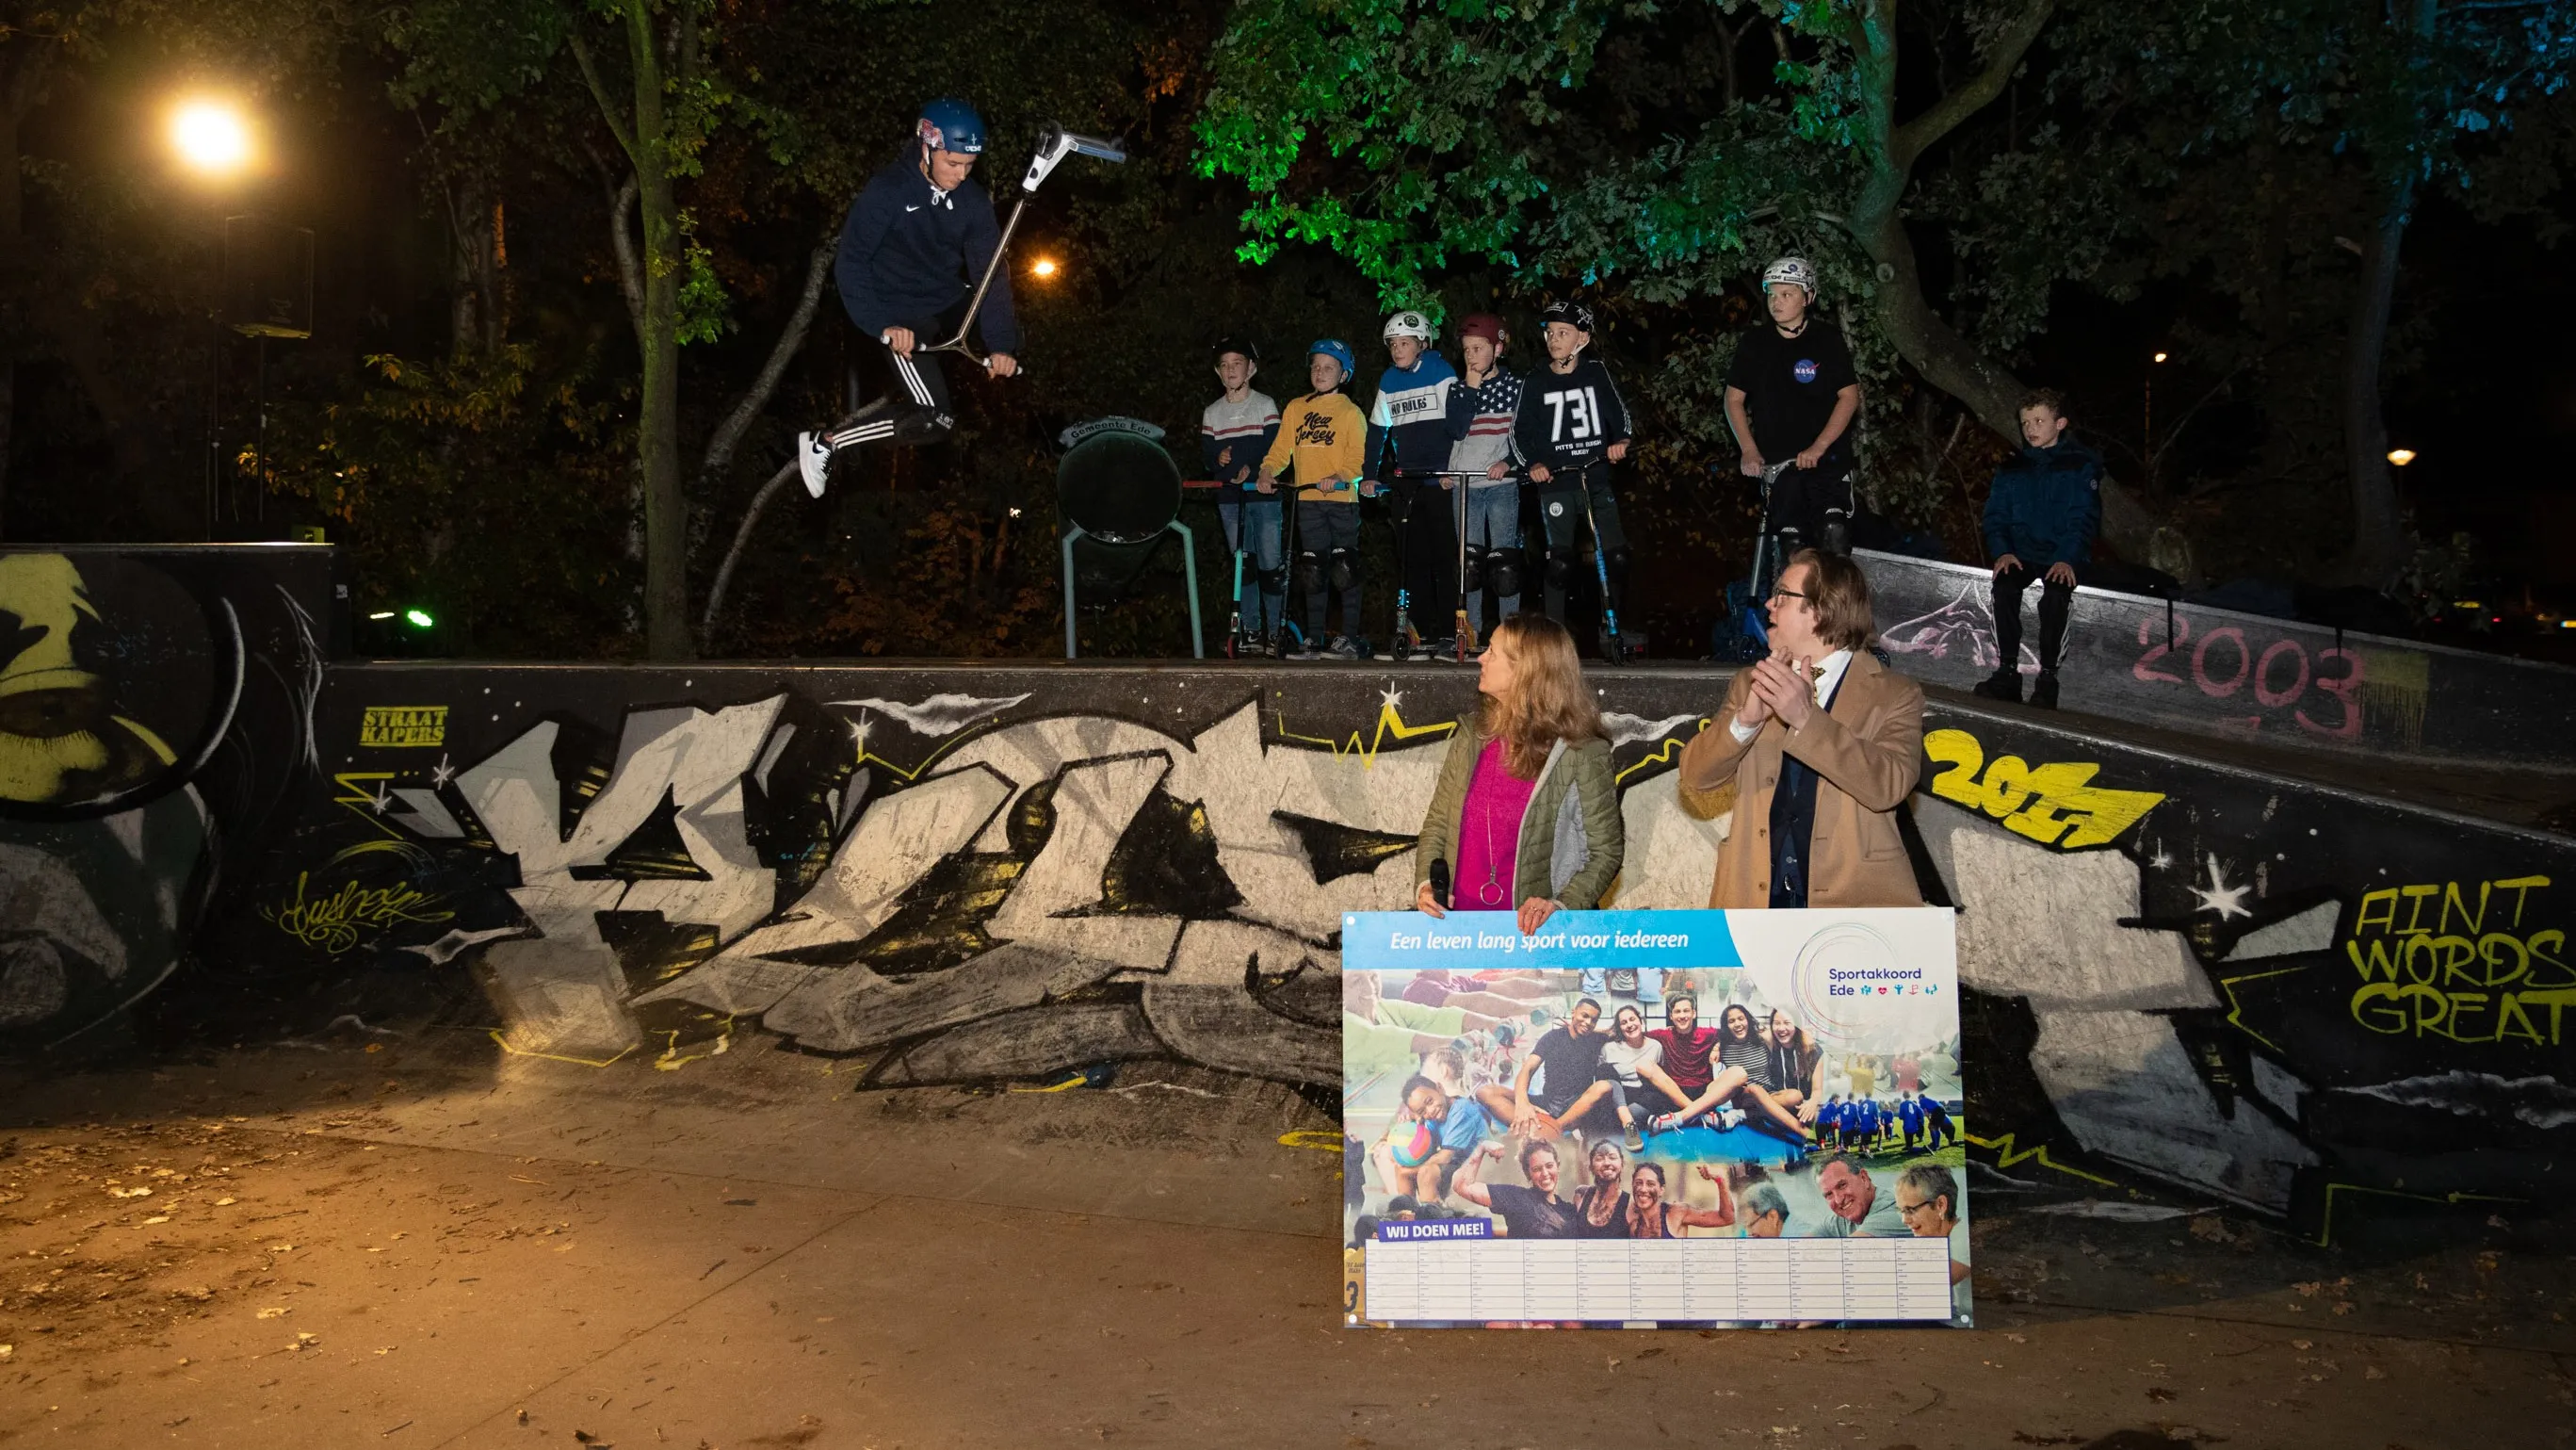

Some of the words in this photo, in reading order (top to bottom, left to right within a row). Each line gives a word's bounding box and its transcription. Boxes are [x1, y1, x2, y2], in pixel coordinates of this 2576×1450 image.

[1391, 401, 1401, 415] NO
[1402, 398, 1427, 413] RULES
[1543, 385, 1602, 443] 731
[1071, 421, 1126, 438] Gemeente
[1130, 423, 1151, 435] Ede
[1304, 412, 1333, 430] New
[1295, 425, 1336, 446] Jersey
[2132, 613, 2365, 738] 2003
[363, 710, 448, 726] STRAAT
[360, 726, 446, 742] KAPERS
[2356, 874, 2552, 936] AINT
[1390, 932, 1421, 950] Een
[1427, 931, 1472, 950] leven
[1477, 931, 1515, 953] lang
[1520, 933, 1566, 953] sport
[1570, 935, 1611, 949] voor
[1614, 929, 1689, 949] iedereen
[2346, 929, 2576, 987] WORDS
[1828, 968, 1921, 982] Sportakkoord
[1829, 985, 1855, 996] Ede
[2350, 982, 2576, 1046] GREAT
[1386, 1226, 1409, 1238] WIJ
[1413, 1224, 1449, 1237] DOEN
[1452, 1223, 1484, 1236] MEE!
